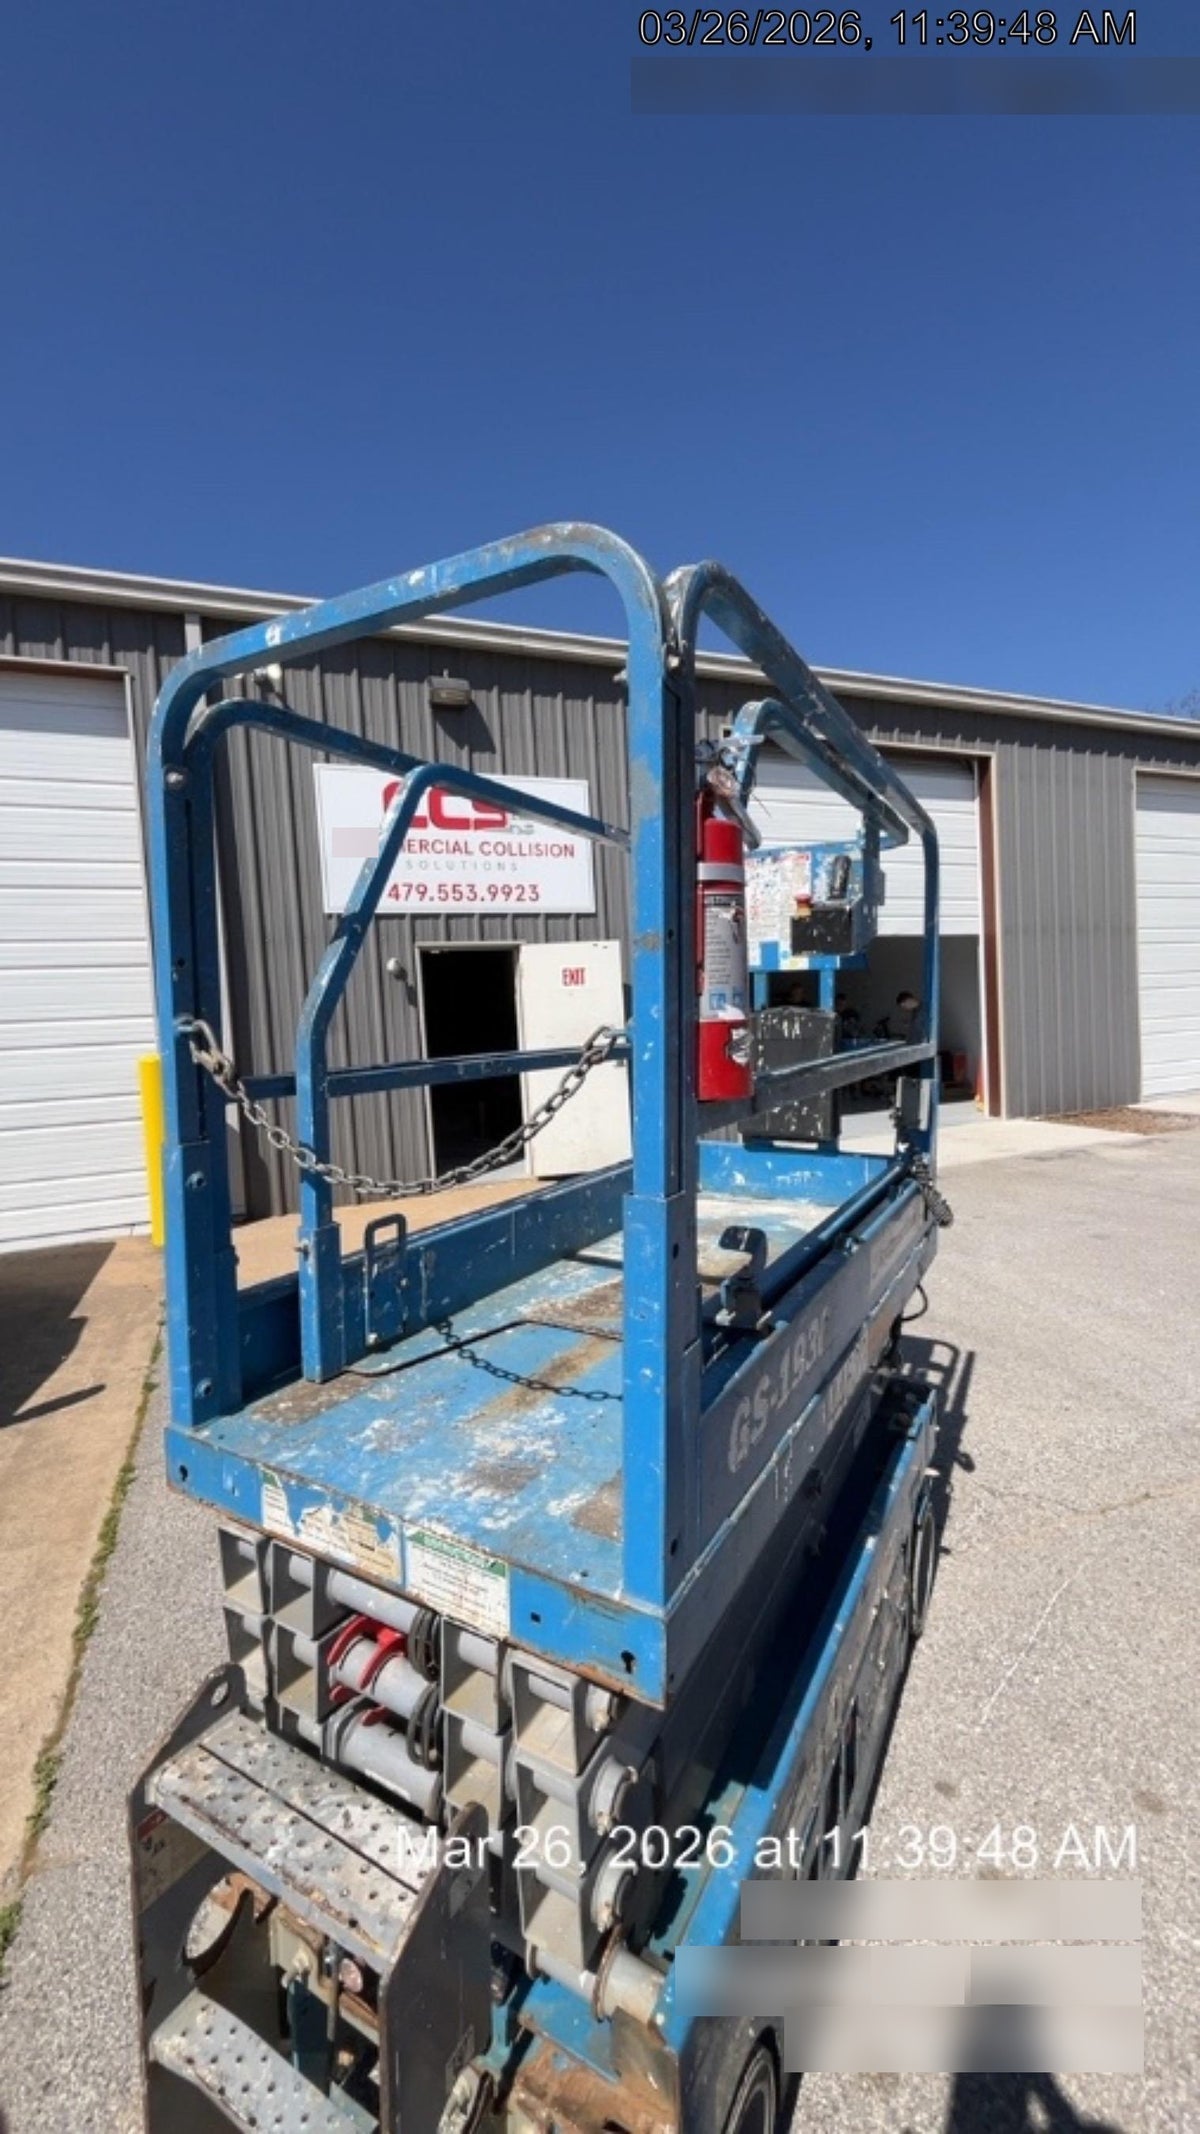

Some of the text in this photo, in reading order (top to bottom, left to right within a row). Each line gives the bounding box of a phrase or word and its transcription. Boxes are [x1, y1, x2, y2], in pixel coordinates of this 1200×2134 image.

[479, 841, 575, 858] COLLISION
[405, 860, 518, 872] SOLUTIONS
[387, 883, 540, 902] 479.553.9923
[562, 967, 586, 986] EXIT
